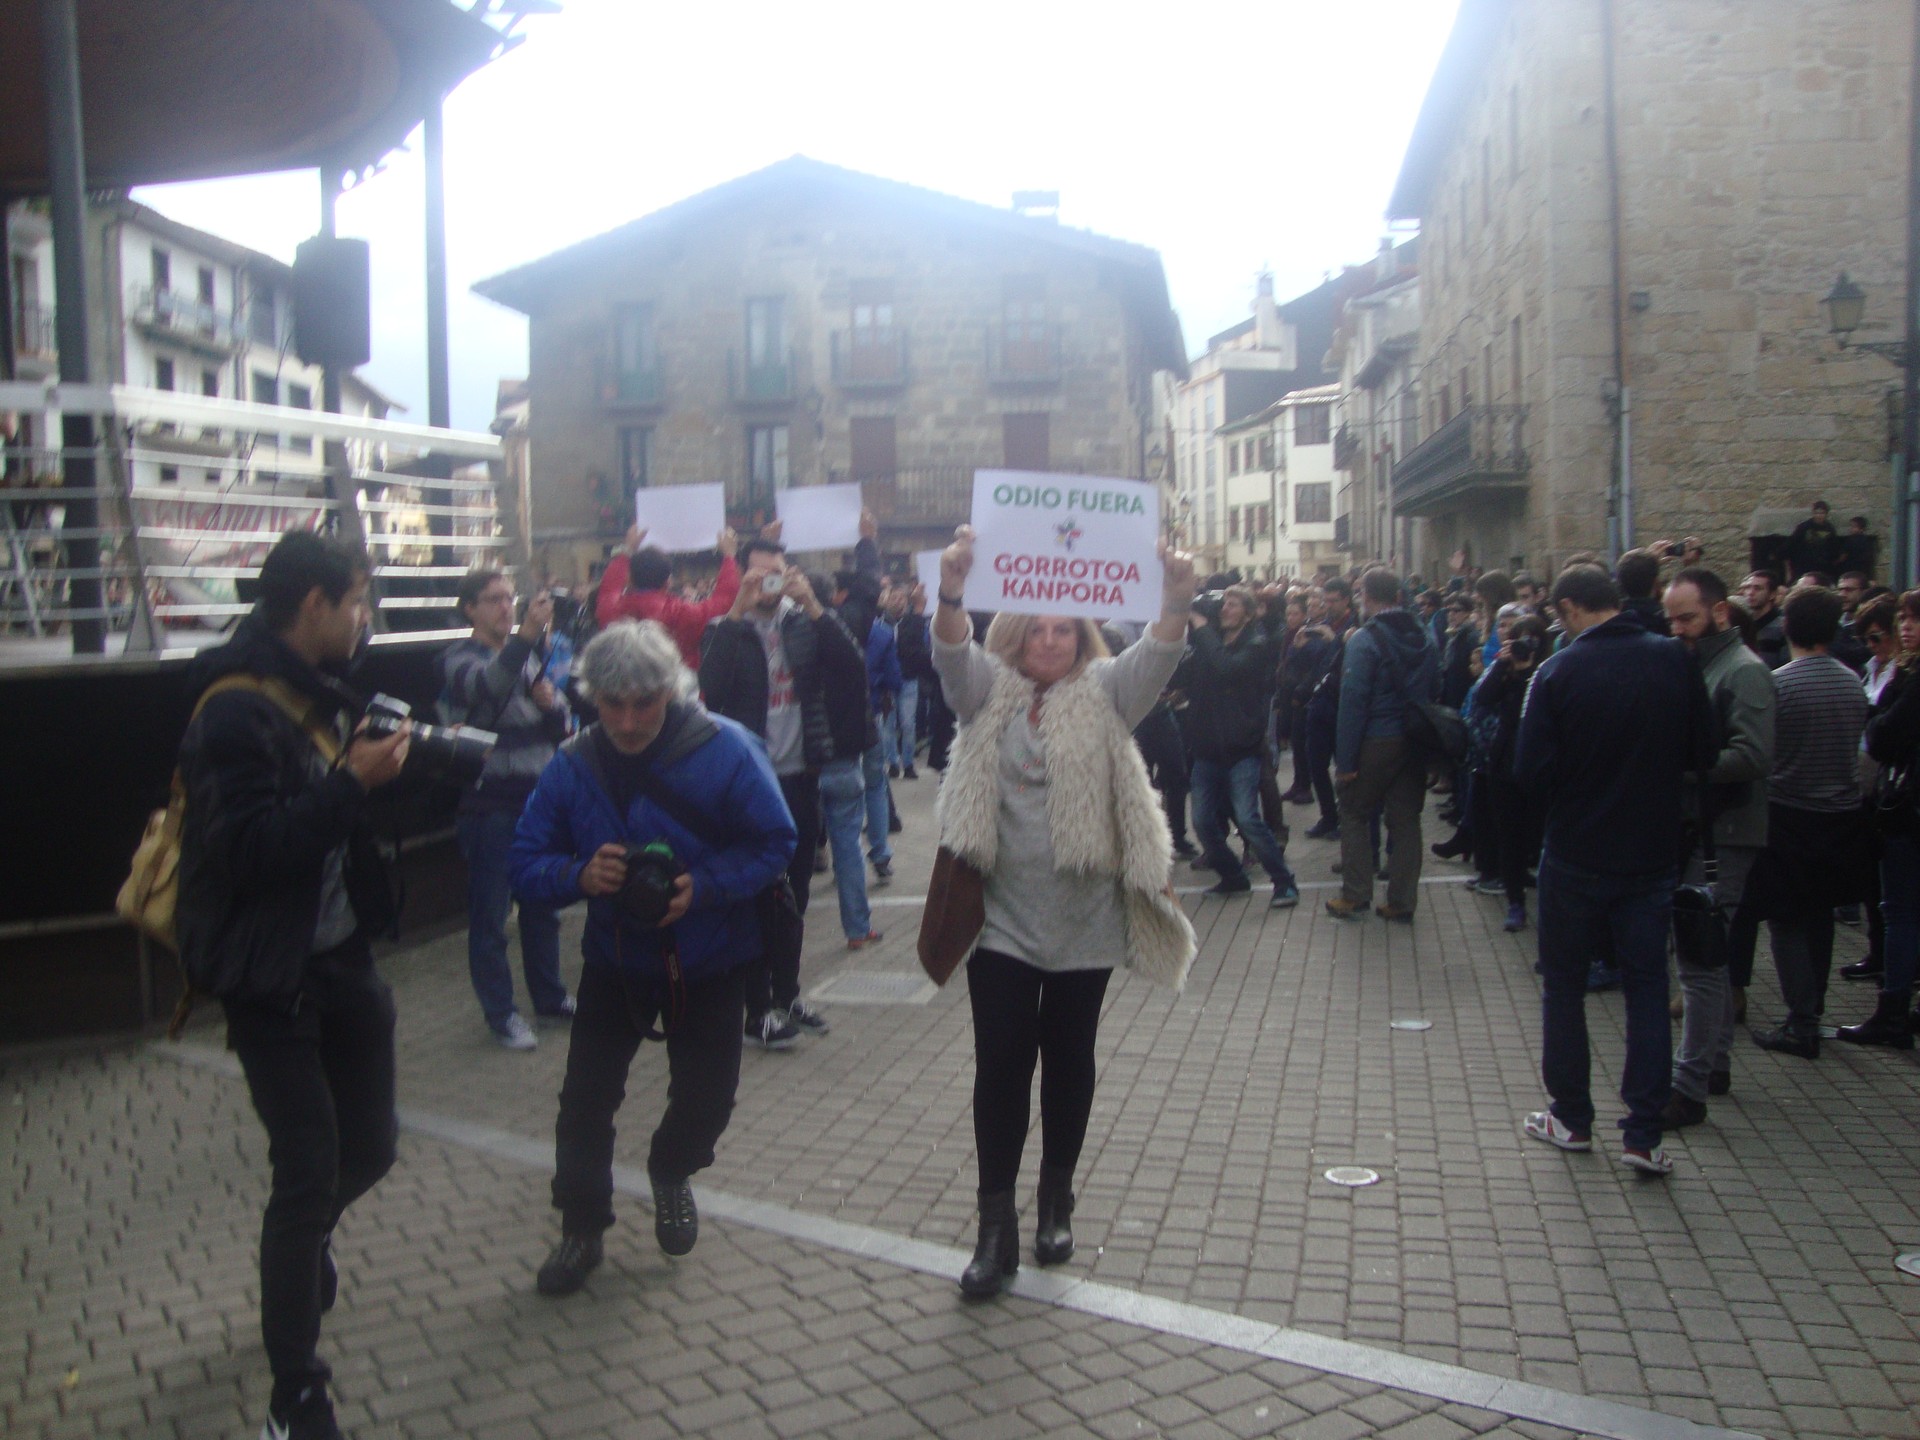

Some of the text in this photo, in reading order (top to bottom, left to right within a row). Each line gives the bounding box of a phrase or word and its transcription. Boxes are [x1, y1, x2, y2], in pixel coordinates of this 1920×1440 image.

[994, 485, 1144, 514] ODIO FUERA
[994, 554, 1140, 583] GORROTOA
[1002, 579, 1125, 605] KANPORA
